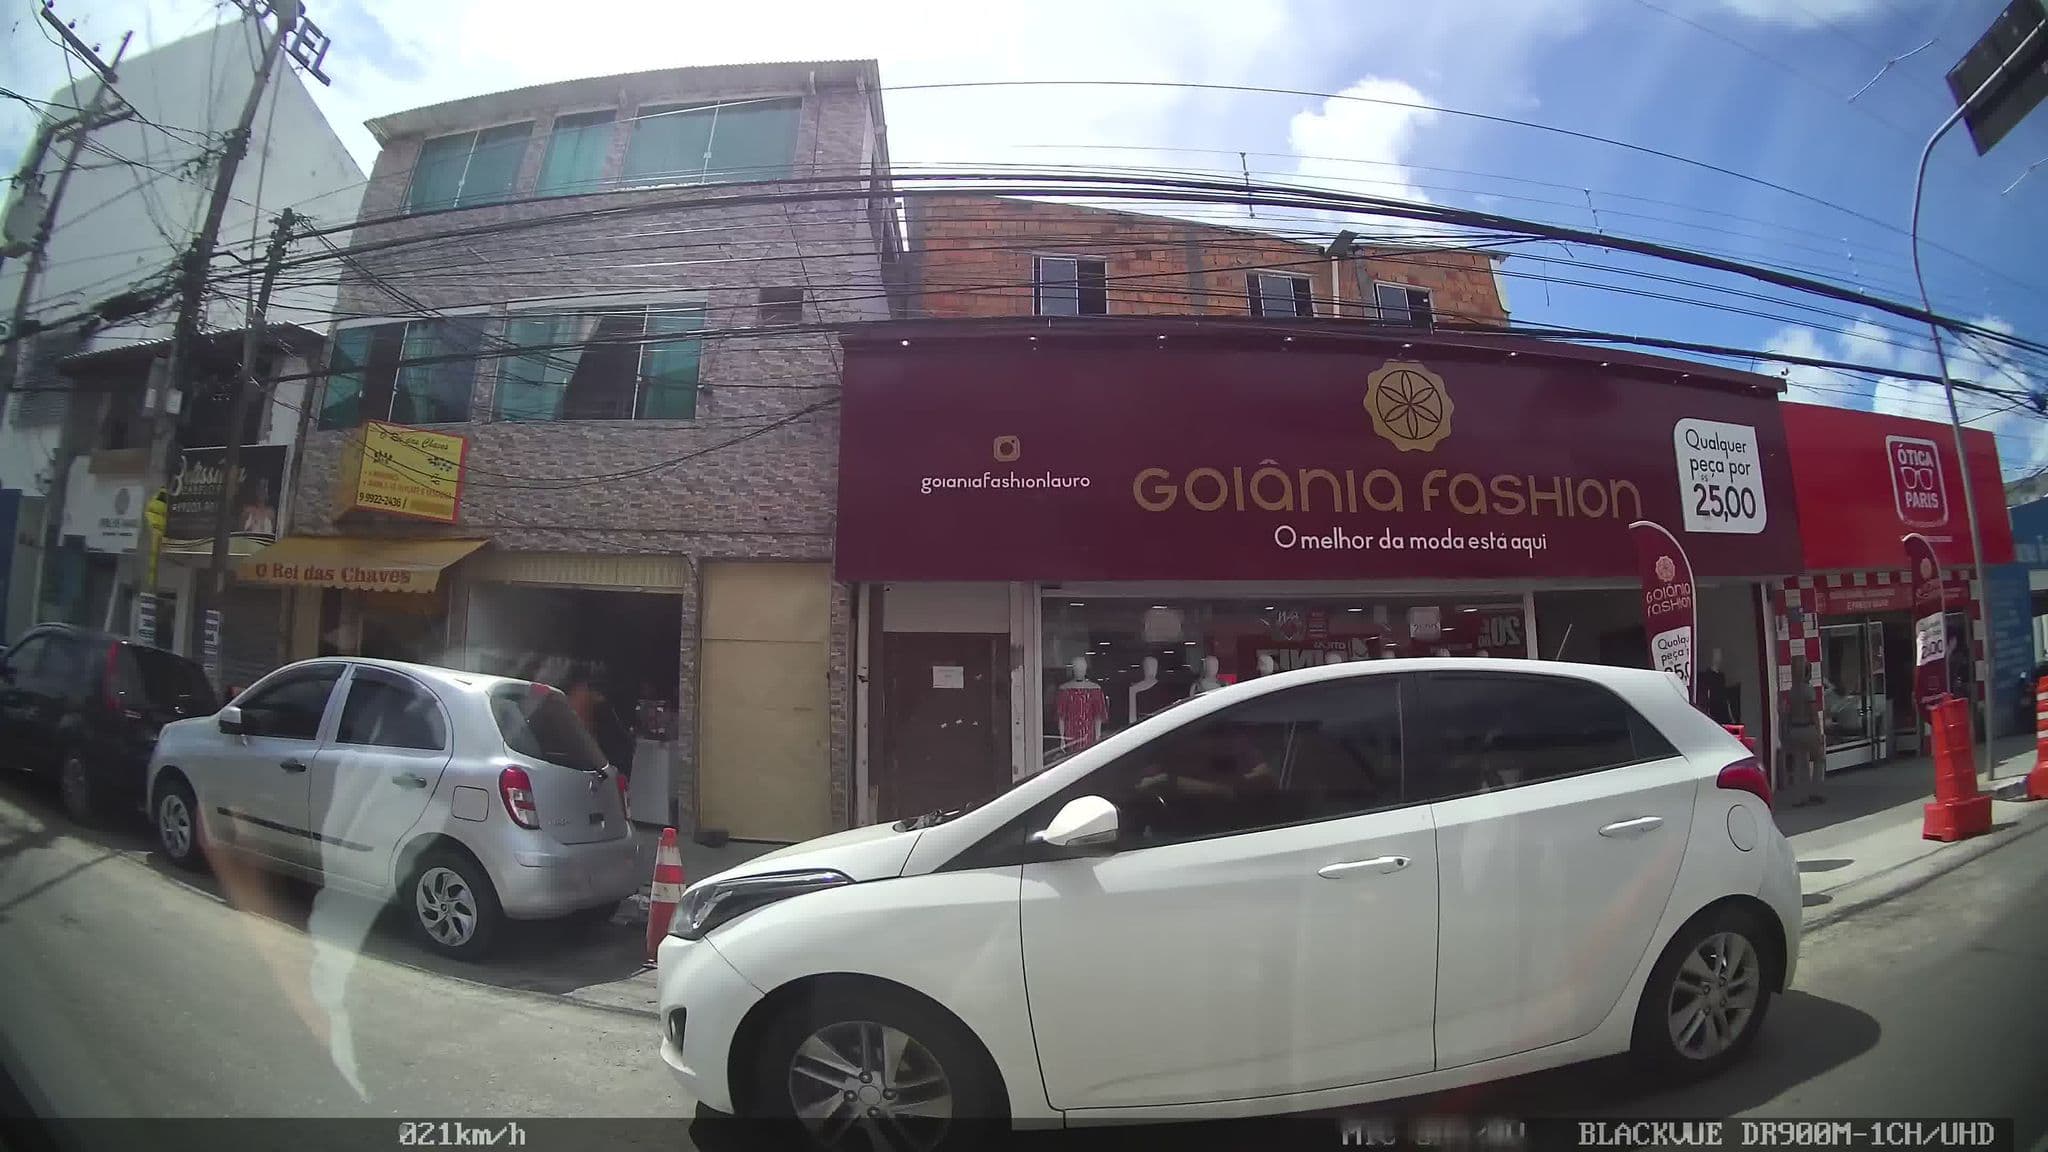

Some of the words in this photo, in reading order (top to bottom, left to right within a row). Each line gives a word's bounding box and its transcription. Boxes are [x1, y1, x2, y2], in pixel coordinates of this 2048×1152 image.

[1685, 428, 1747, 459] Qualquer
[1897, 443, 1934, 467] ÓTICA
[921, 471, 1091, 494] goianiafashionlauro
[1689, 458, 1725, 480] peça
[1729, 462, 1751, 483] por
[1693, 483, 1756, 523] 25,00
[1905, 491, 1939, 508] PARIS
[1274, 525, 1297, 549] O
[1301, 527, 1374, 549] melhor
[1379, 527, 1404, 549] da
[1410, 527, 1464, 549] moda
[1468, 531, 1508, 549] está
[1511, 533, 1547, 559] aqui
[272, 562, 298, 579] Rei
[304, 565, 335, 581] das
[341, 566, 412, 584] Chaves
